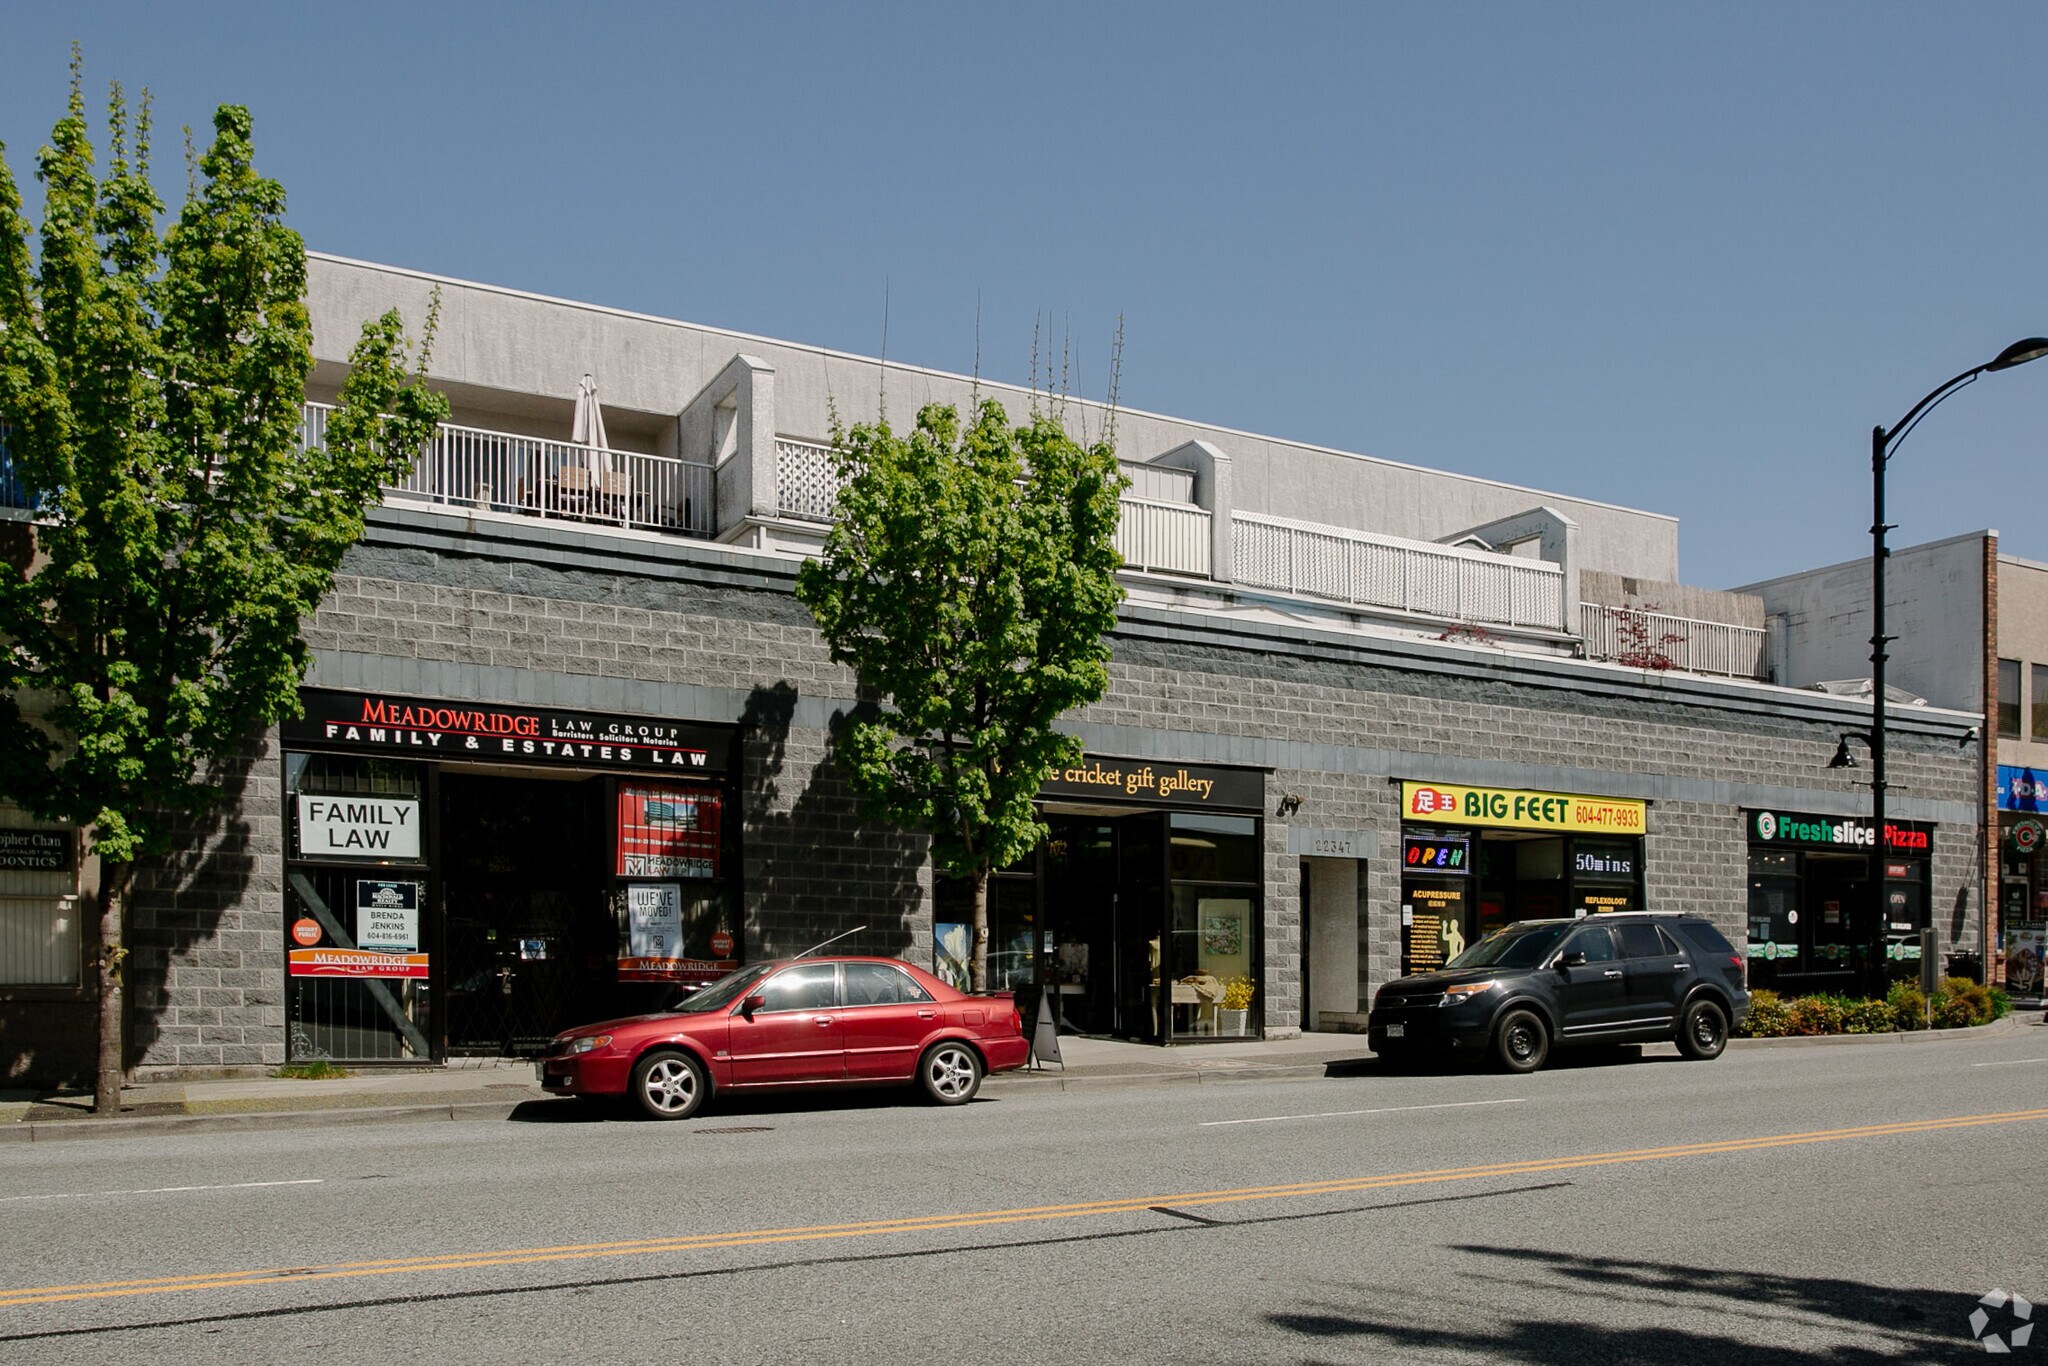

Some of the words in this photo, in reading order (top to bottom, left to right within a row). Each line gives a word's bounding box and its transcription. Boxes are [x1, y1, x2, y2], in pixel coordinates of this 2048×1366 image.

[361, 698, 540, 736] MEADOWRIDGE
[552, 719, 592, 731] LAW
[609, 724, 678, 738] GROUP
[326, 724, 442, 746] FAMILY
[465, 735, 479, 749] &
[502, 738, 632, 761] ESTATES
[652, 750, 706, 766] LAW
[552, 730, 594, 740] Barristers
[599, 733, 638, 744] Solicitors
[643, 737, 678, 747] Notaries
[1065, 763, 1121, 786] cricket
[1126, 767, 1155, 795] gift
[1159, 770, 1213, 799] gallery
[1416, 791, 1454, 812] 足王
[1464, 792, 1508, 819] BIG
[1514, 796, 1569, 823] FEET
[310, 802, 411, 825] FAMILY
[1576, 806, 1639, 827] 604-477-9933
[329, 828, 390, 849] LAW
[1779, 816, 1875, 845] Freshslice
[32, 834, 61, 847] Chan
[1316, 840, 1350, 854] 22347
[1407, 846, 1463, 866] OPEN
[1576, 853, 1631, 872] 50mins
[637, 891, 673, 906] WE'VE
[1413, 890, 1461, 899] ACUPRESSURE
[1585, 896, 1627, 905] REFLEXOLOGY
[371, 911, 404, 920] BRENDA
[639, 906, 672, 918] MOVED!
[371, 922, 405, 930] JENKINS
[314, 953, 408, 965] MEADOWRIDGE
[640, 961, 719, 970] MEADOWRIDGE
